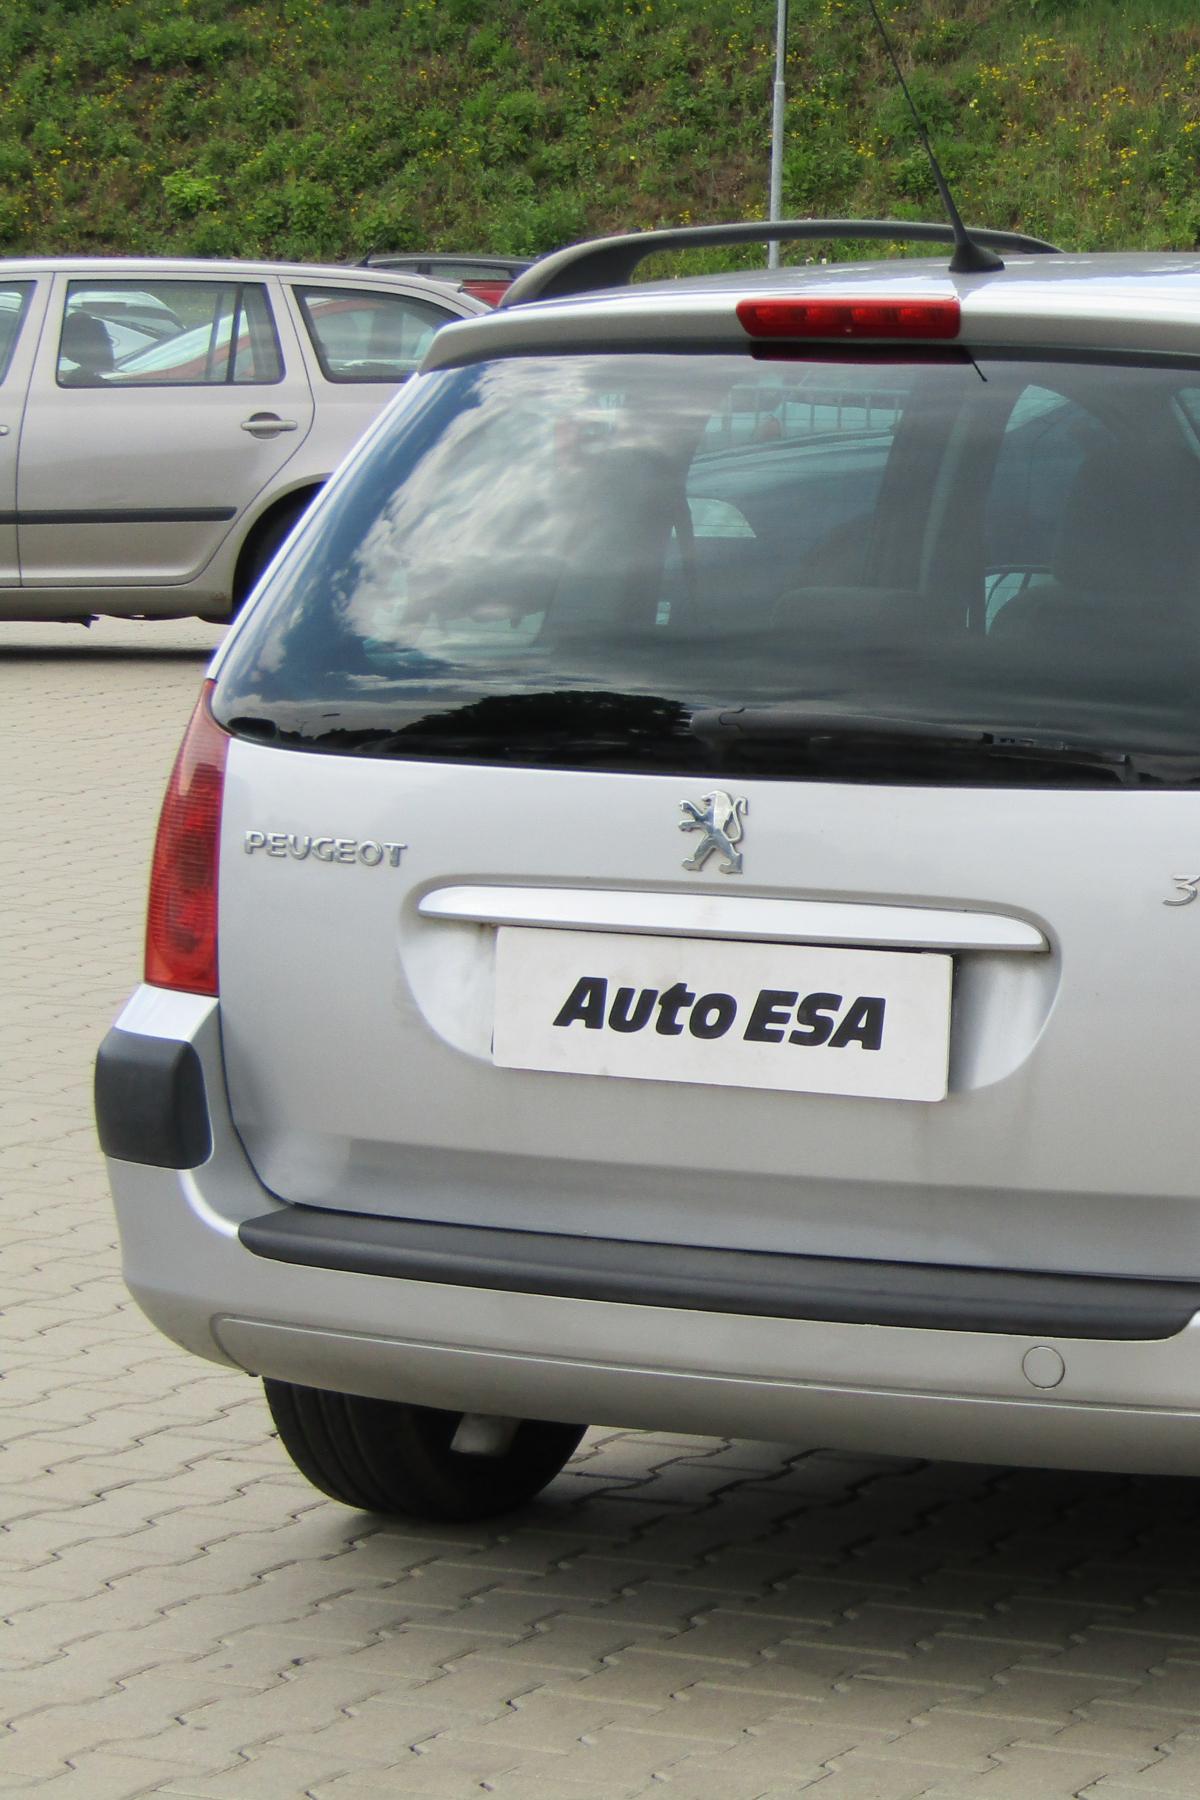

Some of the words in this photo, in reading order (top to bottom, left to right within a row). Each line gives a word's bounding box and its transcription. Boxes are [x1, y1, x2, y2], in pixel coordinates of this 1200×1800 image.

[244, 830, 408, 868] PEUGEOT
[552, 976, 738, 1040] Auto
[742, 989, 887, 1051] ESA
